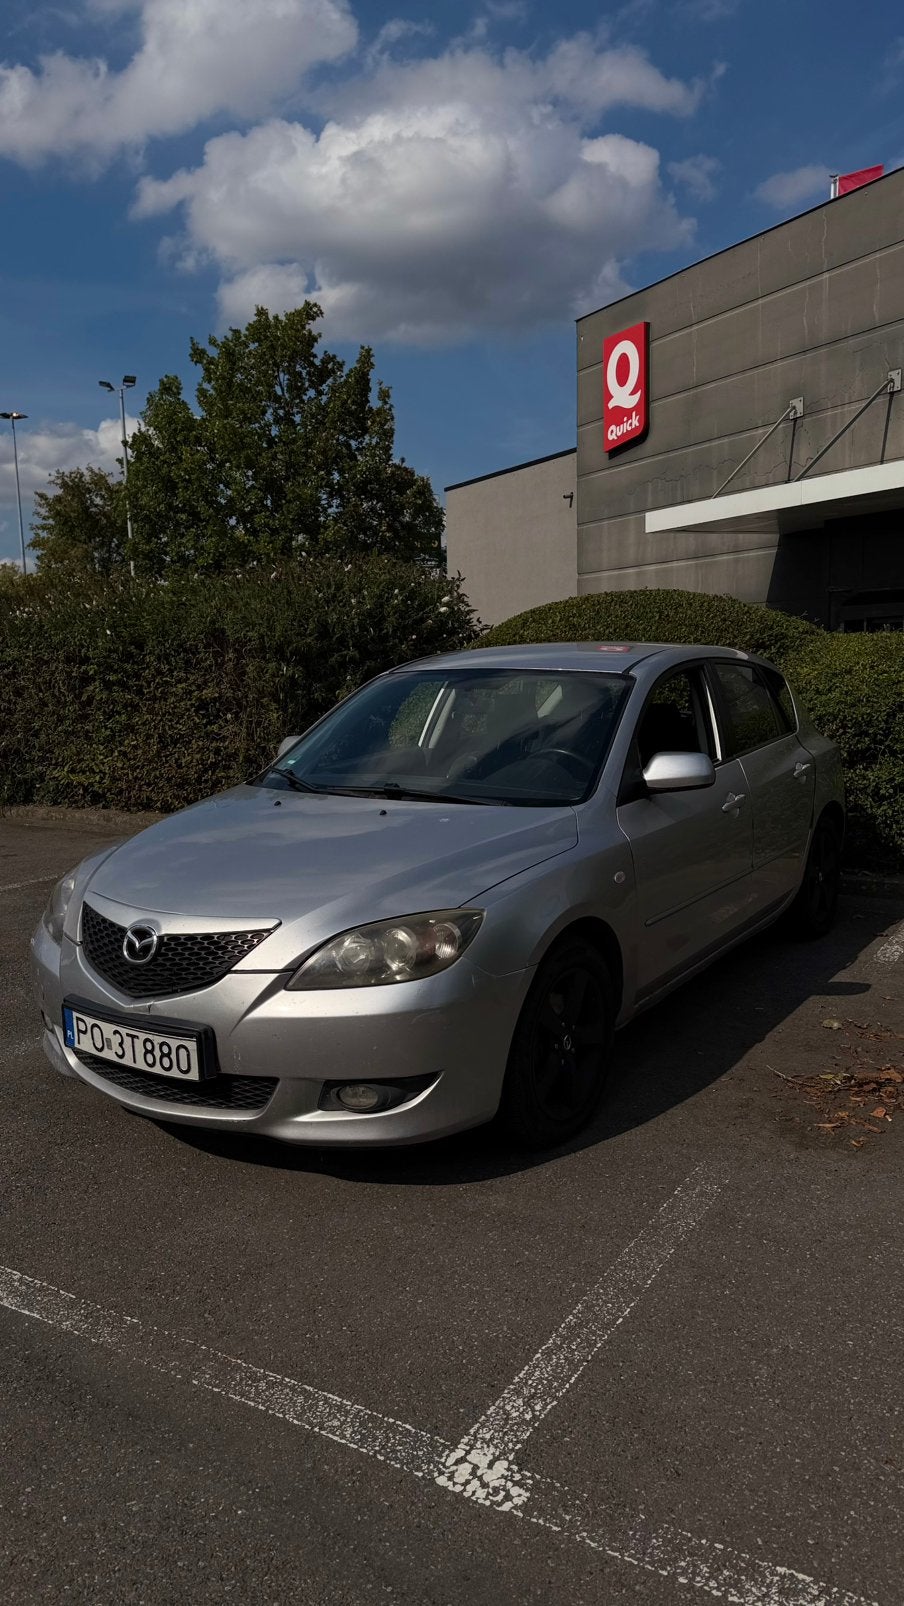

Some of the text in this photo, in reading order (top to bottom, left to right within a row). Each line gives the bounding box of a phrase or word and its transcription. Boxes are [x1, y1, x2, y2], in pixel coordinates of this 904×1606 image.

[607, 340, 641, 409] Q
[607, 411, 639, 440] Quick
[76, 1016, 191, 1074] PO 3T880
